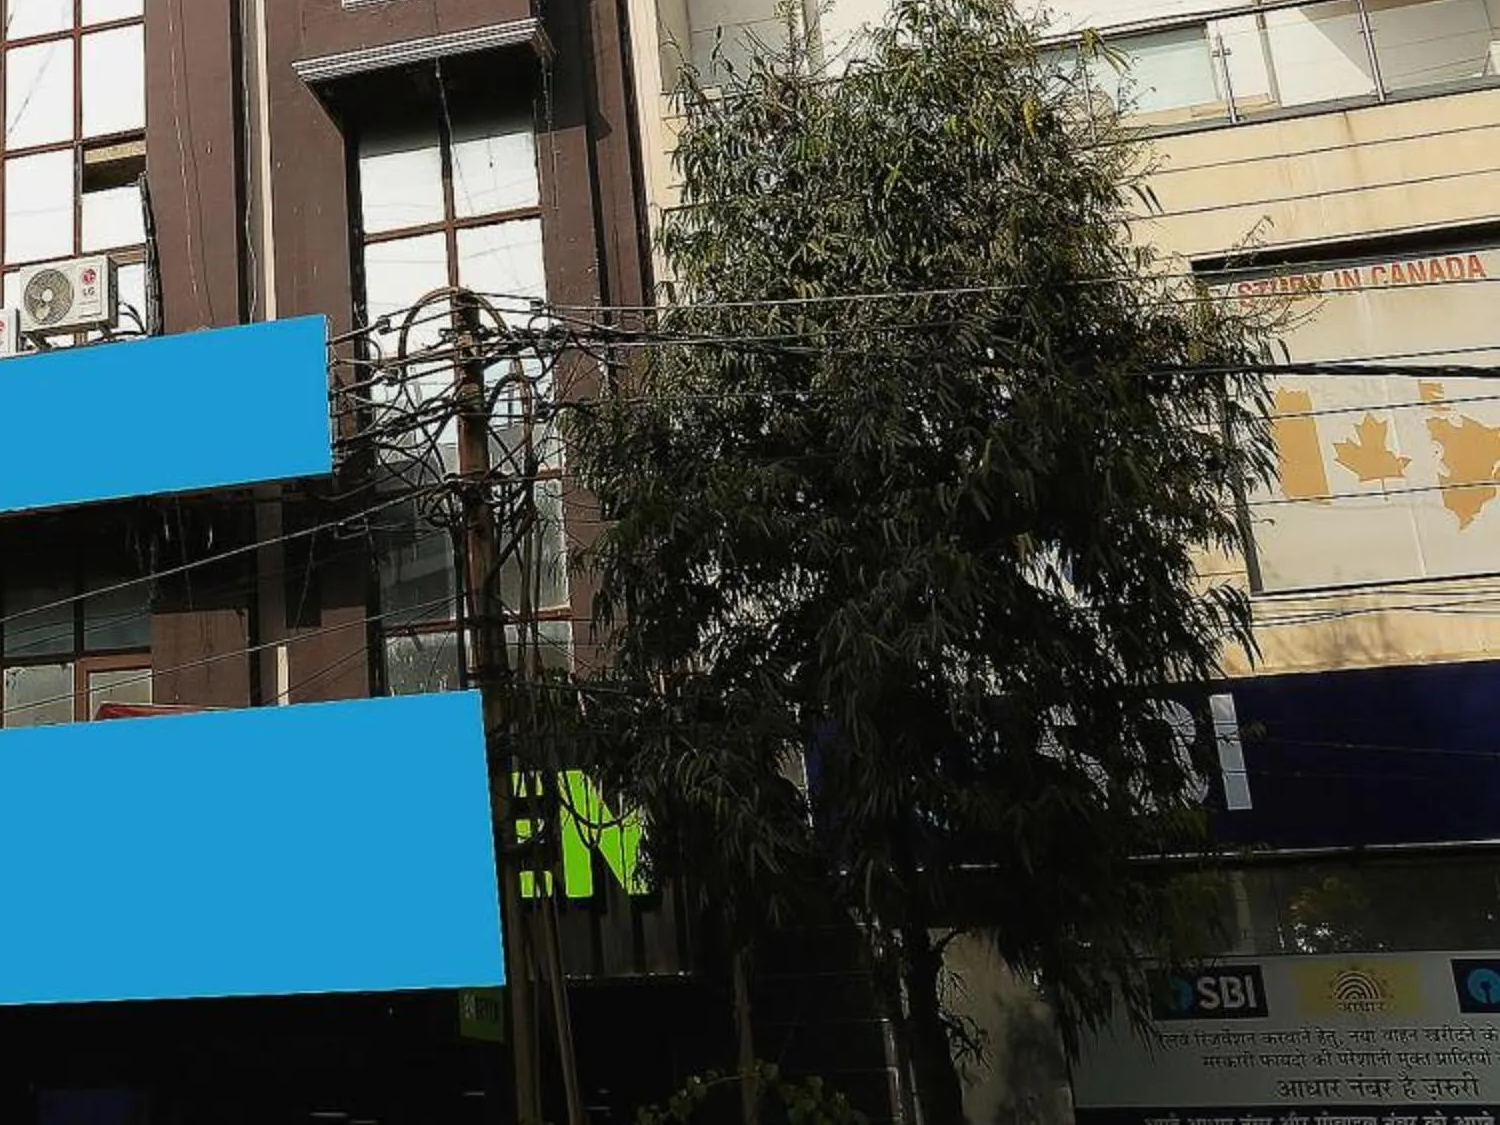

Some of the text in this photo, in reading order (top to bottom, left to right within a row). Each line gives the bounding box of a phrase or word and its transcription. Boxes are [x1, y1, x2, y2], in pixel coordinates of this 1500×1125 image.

[1370, 254, 1488, 287] CANADA
[1199, 975, 1257, 1010] SBI
[1277, 1080, 1341, 1097] आधार
[1346, 1073, 1394, 1097] नंबर
